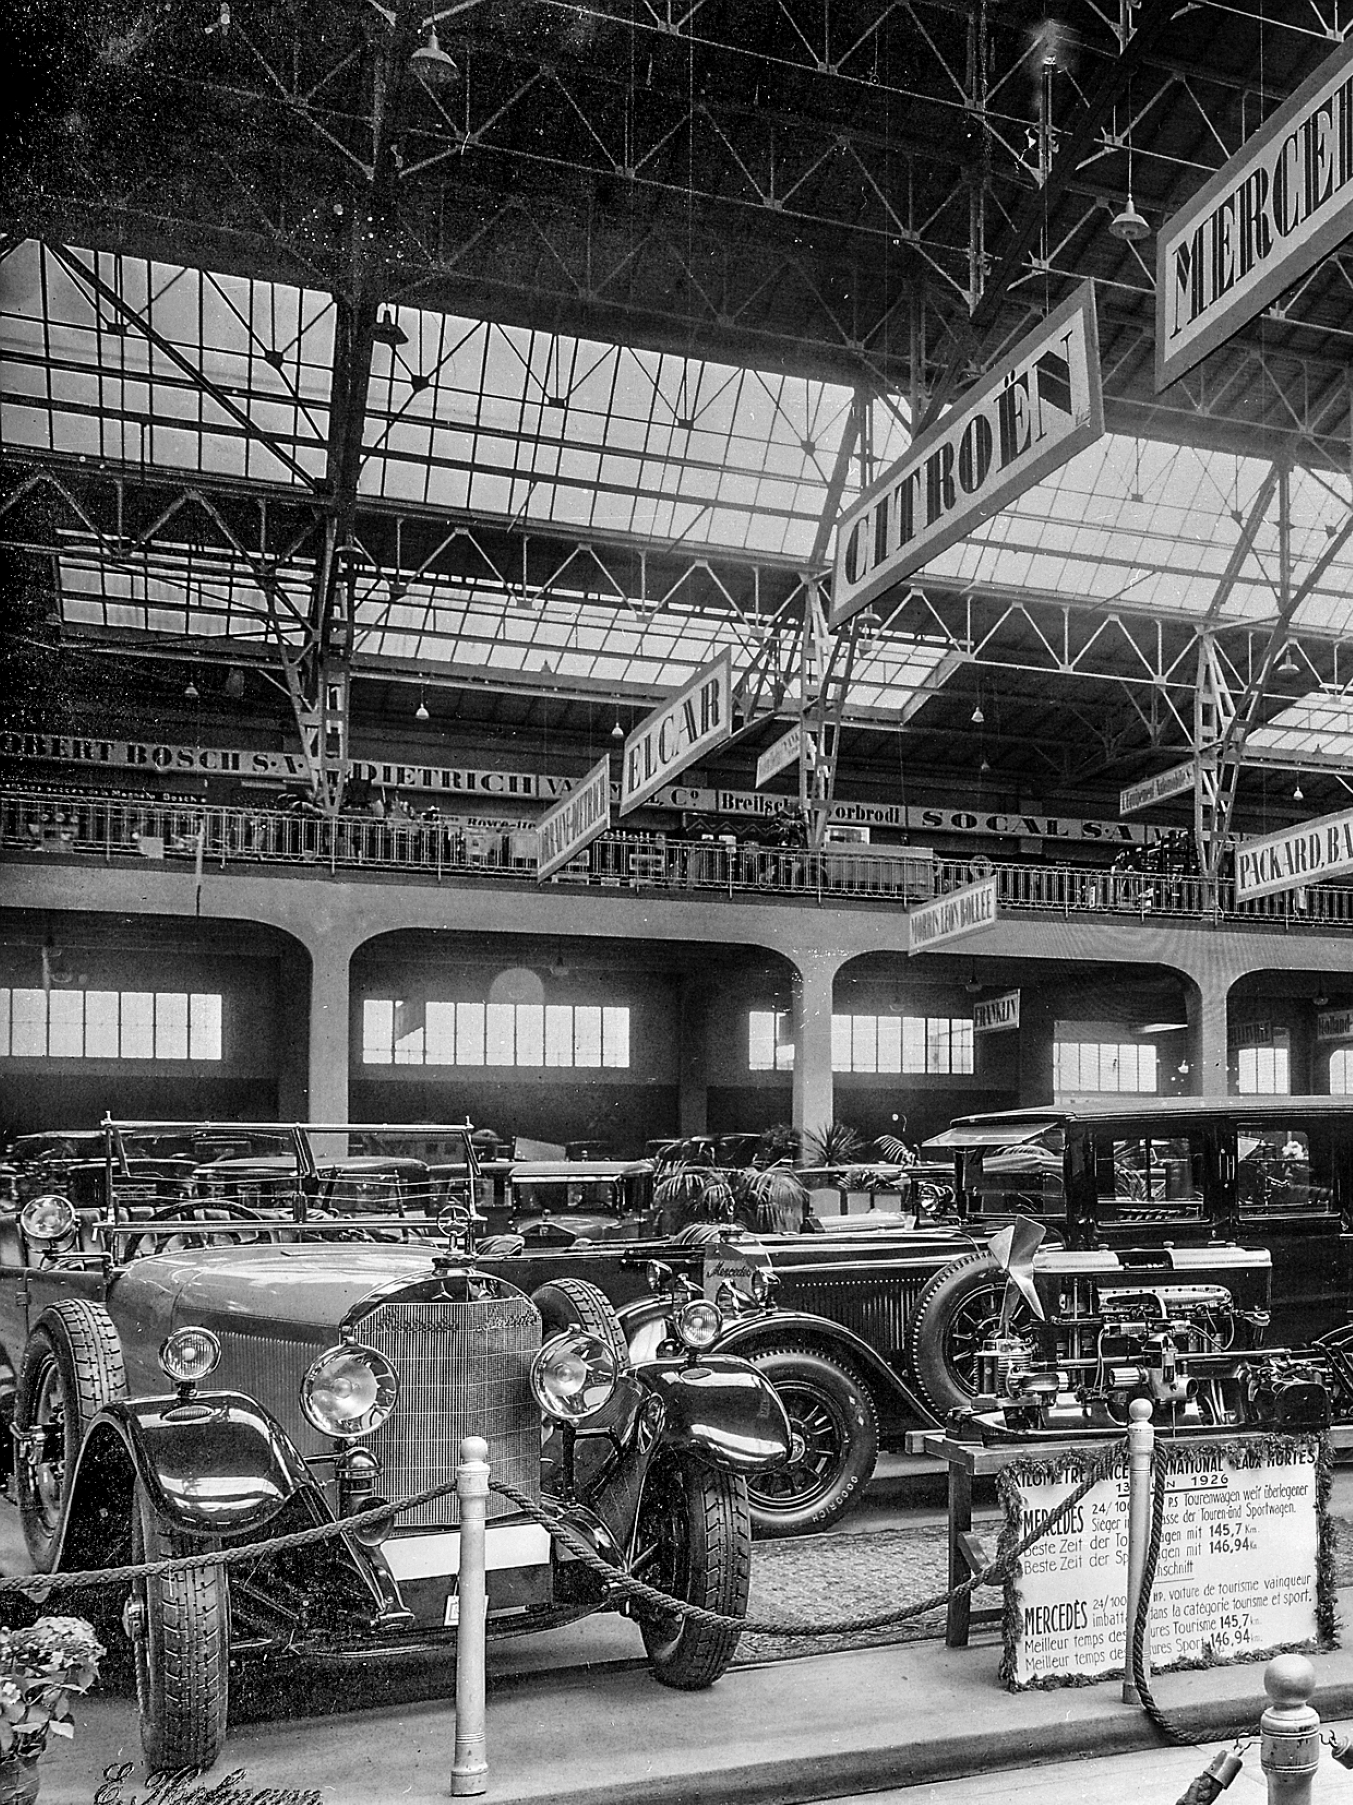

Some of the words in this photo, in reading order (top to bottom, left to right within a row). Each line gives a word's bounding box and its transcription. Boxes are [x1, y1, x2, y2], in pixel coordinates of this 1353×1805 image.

[845, 330, 1073, 585] CITROËN
[628, 678, 721, 794] ELCAR
[126, 744, 241, 771] BOSCH
[351, 763, 533, 794] DIETRICH
[922, 811, 1068, 837] SOCAL
[812, 1475, 858, 1522] GOODRICH
[1115, 1483, 1130, 1493] 13
[1191, 1474, 1229, 1486] 1926
[1184, 1490, 1240, 1507] Tourenwagen
[1243, 1485, 1262, 1501] weit
[1264, 1483, 1309, 1500] überlegener
[1092, 1517, 1121, 1533] Sieger
[1183, 1509, 1196, 1523] der
[1059, 1537, 1083, 1554] Zeit
[1090, 1535, 1110, 1550] der
[1187, 1525, 1202, 1540] mit
[1209, 1522, 1243, 1538] 145,7
[1024, 1559, 1057, 1575] Beste
[1060, 1555, 1082, 1571] Zeit
[1089, 1554, 1110, 1568] der
[1186, 1542, 1202, 1556] mit
[1209, 1537, 1249, 1554] 146,94
[1169, 1586, 1200, 1600] voiture
[1203, 1584, 1215, 1596] de
[1218, 1580, 1259, 1594] tourisme
[1264, 1574, 1311, 1591] vainqueur
[1172, 1604, 1181, 1617] la
[1233, 1594, 1269, 1611] tourisme
[1271, 1593, 1281, 1606] et
[1283, 1588, 1313, 1606] sport.
[1024, 1636, 1069, 1654] Meilleur
[1074, 1632, 1104, 1649] temps
[1173, 1619, 1217, 1635] Tourisme
[1220, 1613, 1249, 1629] 145,7
[1025, 1655, 1069, 1672] Meilleur
[1075, 1650, 1105, 1666] temps
[1175, 1635, 1204, 1654] Sport
[1210, 1628, 1250, 1648] 146,94
